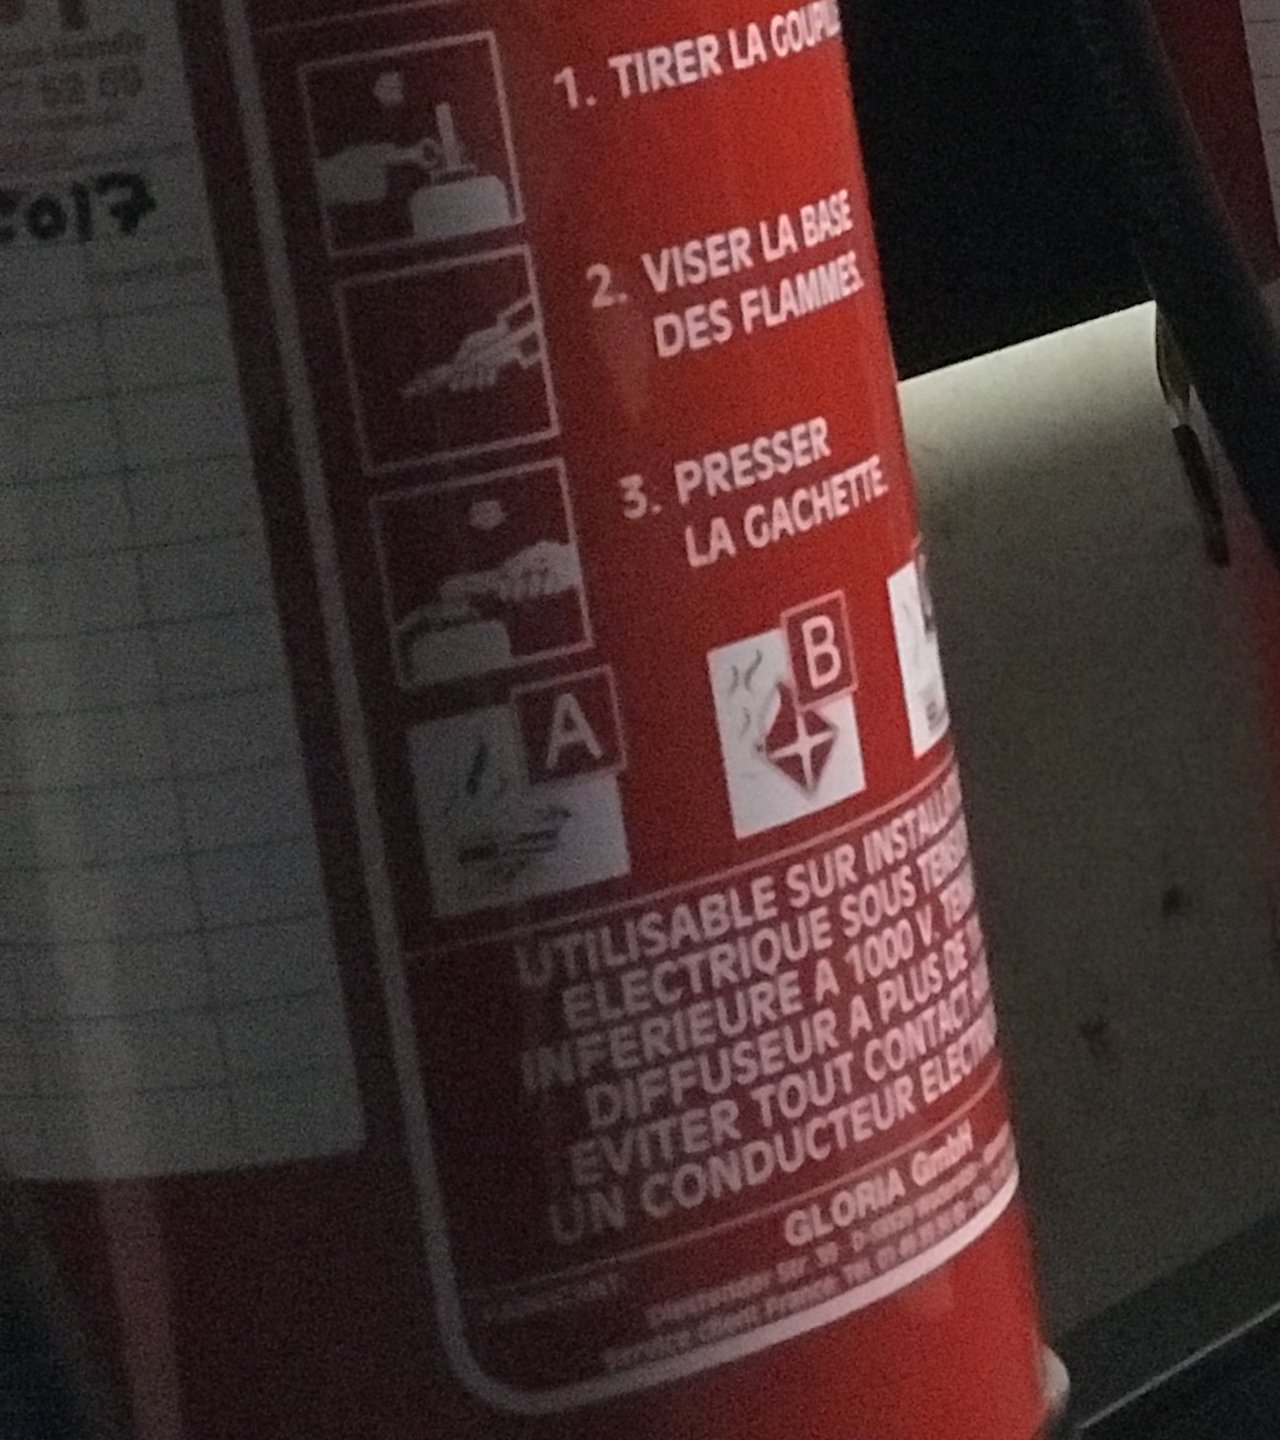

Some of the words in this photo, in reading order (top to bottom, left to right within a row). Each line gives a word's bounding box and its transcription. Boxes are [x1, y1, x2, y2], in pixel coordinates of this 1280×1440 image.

[554, 68, 595, 110] 1.
[609, 34, 722, 99] TIRER
[728, 22, 767, 69] LA
[586, 263, 627, 309] 2.
[642, 227, 753, 294] VISER
[759, 213, 796, 261] LA
[800, 188, 853, 249] BASE
[654, 303, 732, 359] DES
[742, 250, 865, 335] FLAMMES
[619, 475, 661, 519] 3.
[674, 416, 831, 504] PRESSER
[685, 524, 735, 568] LA
[744, 455, 888, 551] GACHETTE
[803, 615, 840, 688] B
[547, 693, 602, 768] A
[517, 875, 776, 987] UTILISABLE
[787, 845, 856, 910] SUR
[562, 907, 832, 1030] ELECTRIQUE
[840, 865, 915, 937] SOUS
[521, 982, 801, 1093] INFERIEURE
[814, 960, 839, 1001] A
[846, 919, 914, 984] 1000
[587, 1009, 839, 1130] DIFFUSEUR
[851, 994, 873, 1039] A
[877, 952, 943, 1024] PLUS
[550, 1194, 626, 1246] UN
[640, 1075, 915, 1217] CONDUCTEUR
[571, 1102, 740, 1186] EVITER
[752, 1057, 854, 1127] TOUT
[784, 1168, 906, 1246] GLORIA
